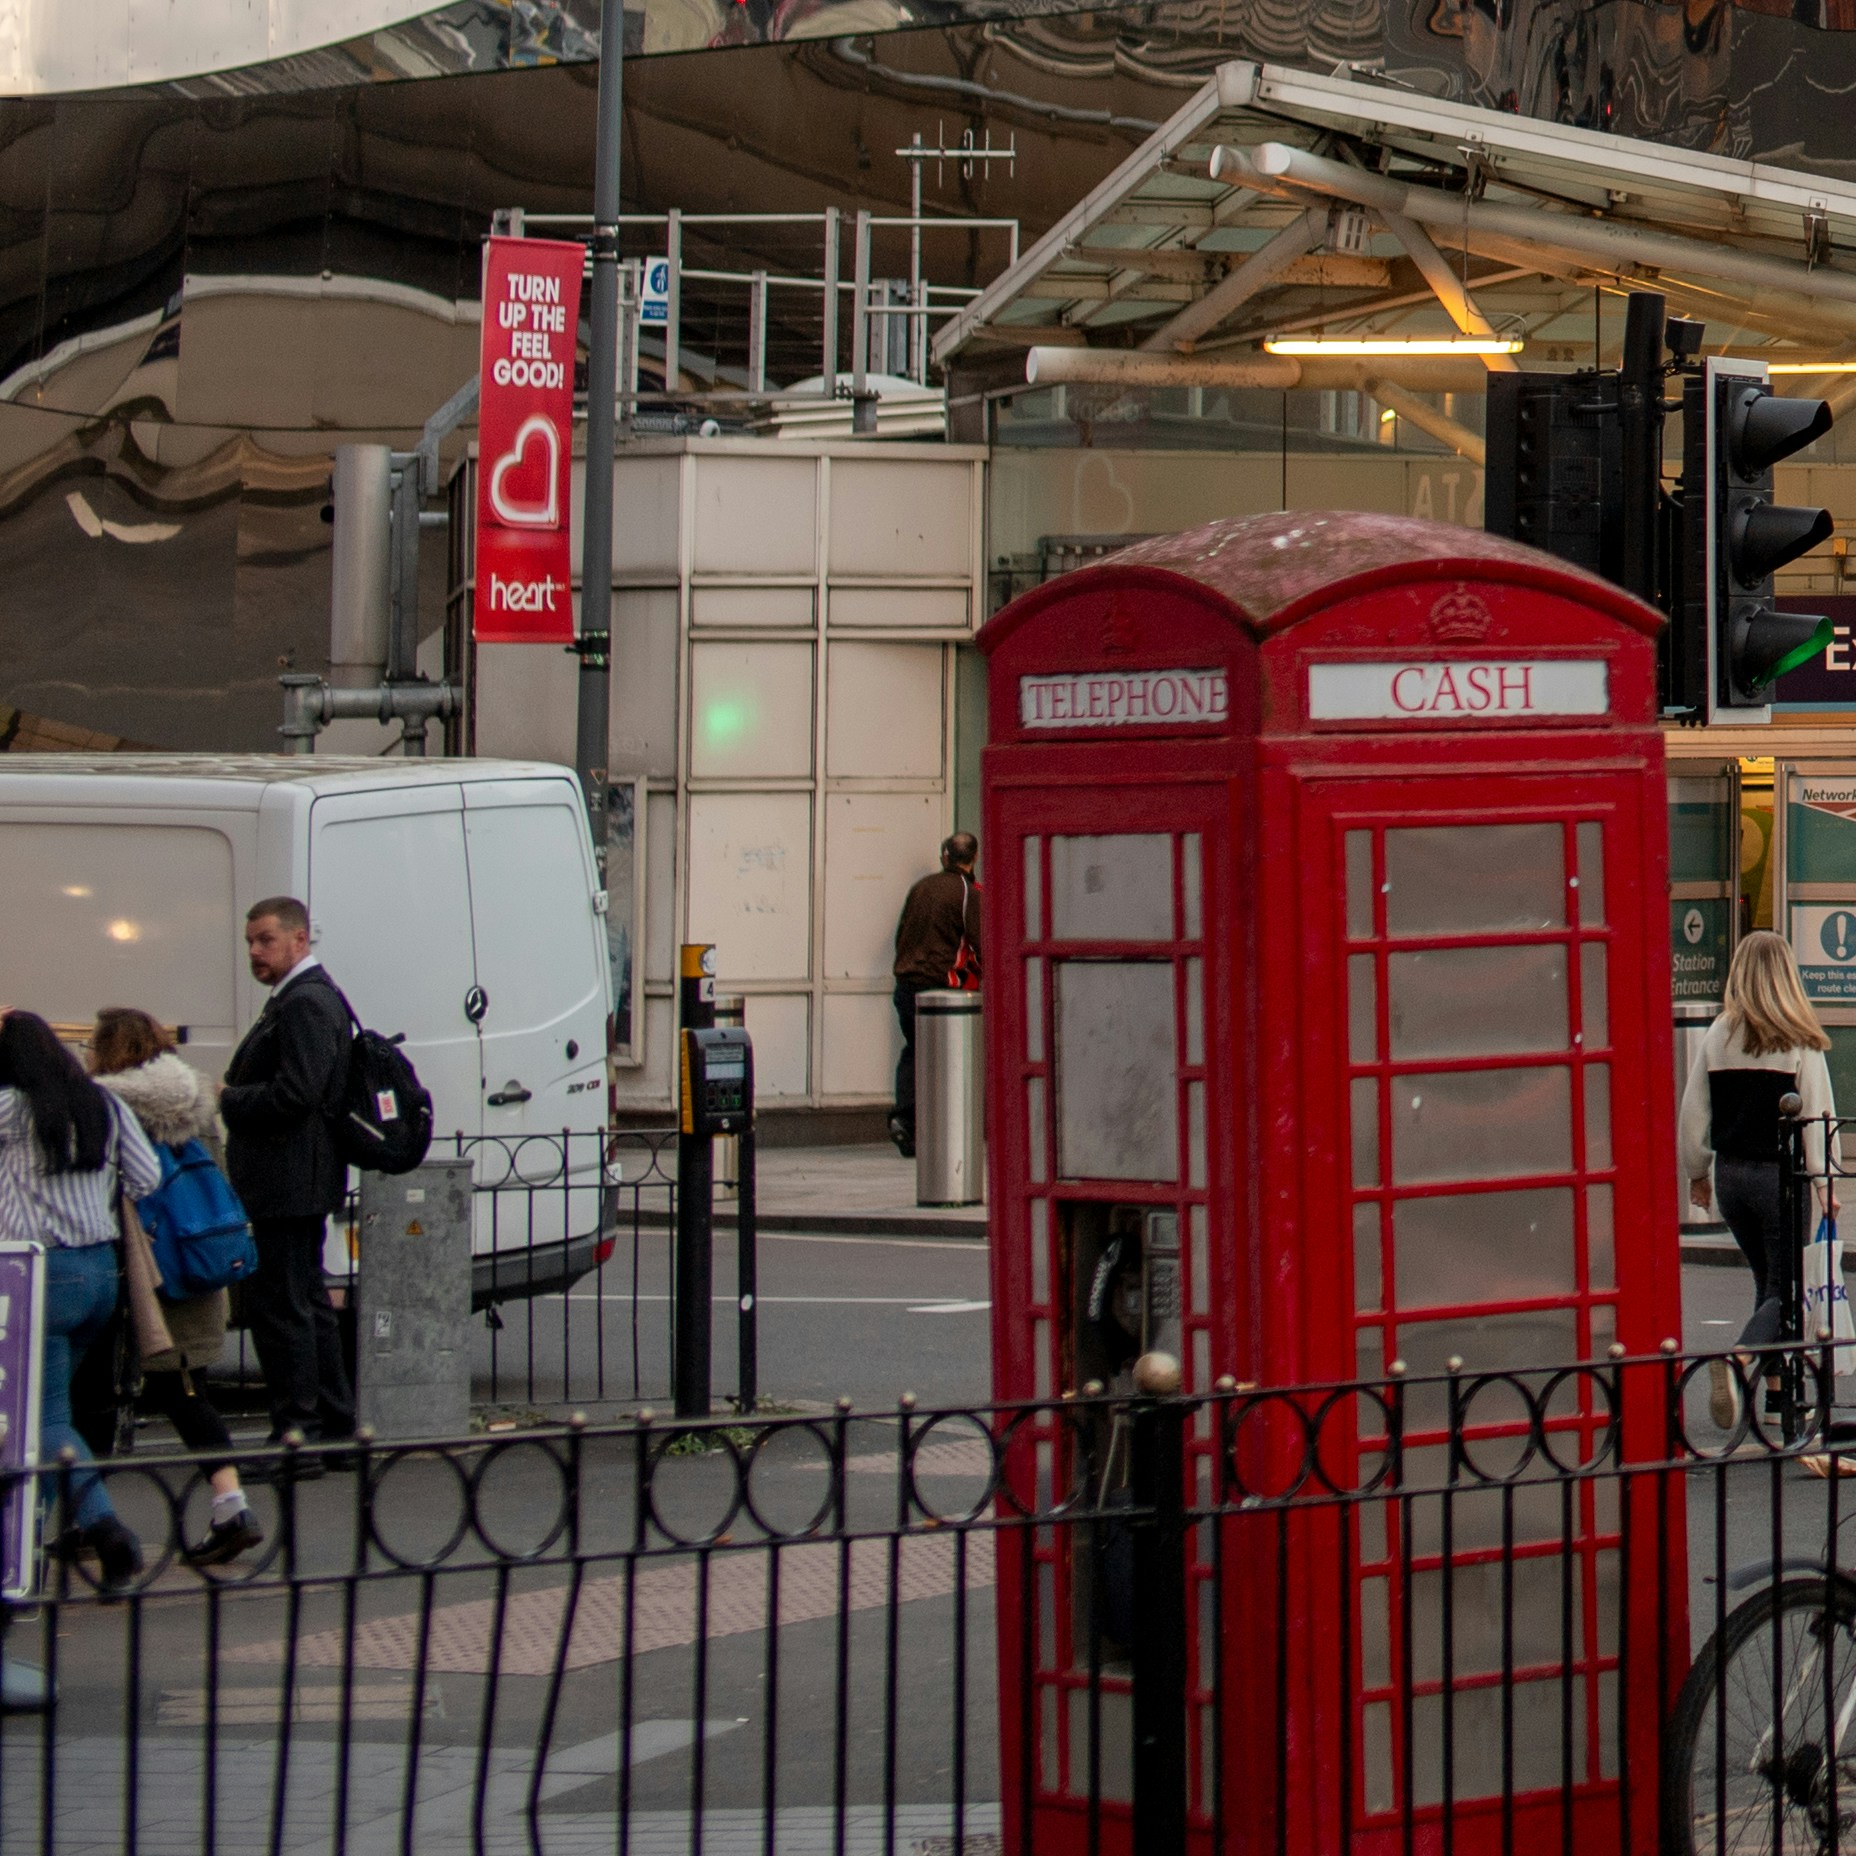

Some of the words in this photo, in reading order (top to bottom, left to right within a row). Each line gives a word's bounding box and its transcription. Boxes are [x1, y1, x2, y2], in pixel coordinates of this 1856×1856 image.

[507, 273, 560, 303] TURN
[498, 302, 527, 330] UP
[532, 304, 565, 333] THE
[511, 331, 551, 360] FEEL
[492, 358, 565, 389] GOOD!
[490, 573, 556, 612] heart
[1027, 671, 1228, 723] TELEPHONE
[1390, 663, 1535, 712] CASH
[1672, 952, 1716, 972] Station
[1802, 969, 1826, 982] Keep
[1827, 969, 1845, 980] this
[1817, 983, 1842, 994] route
